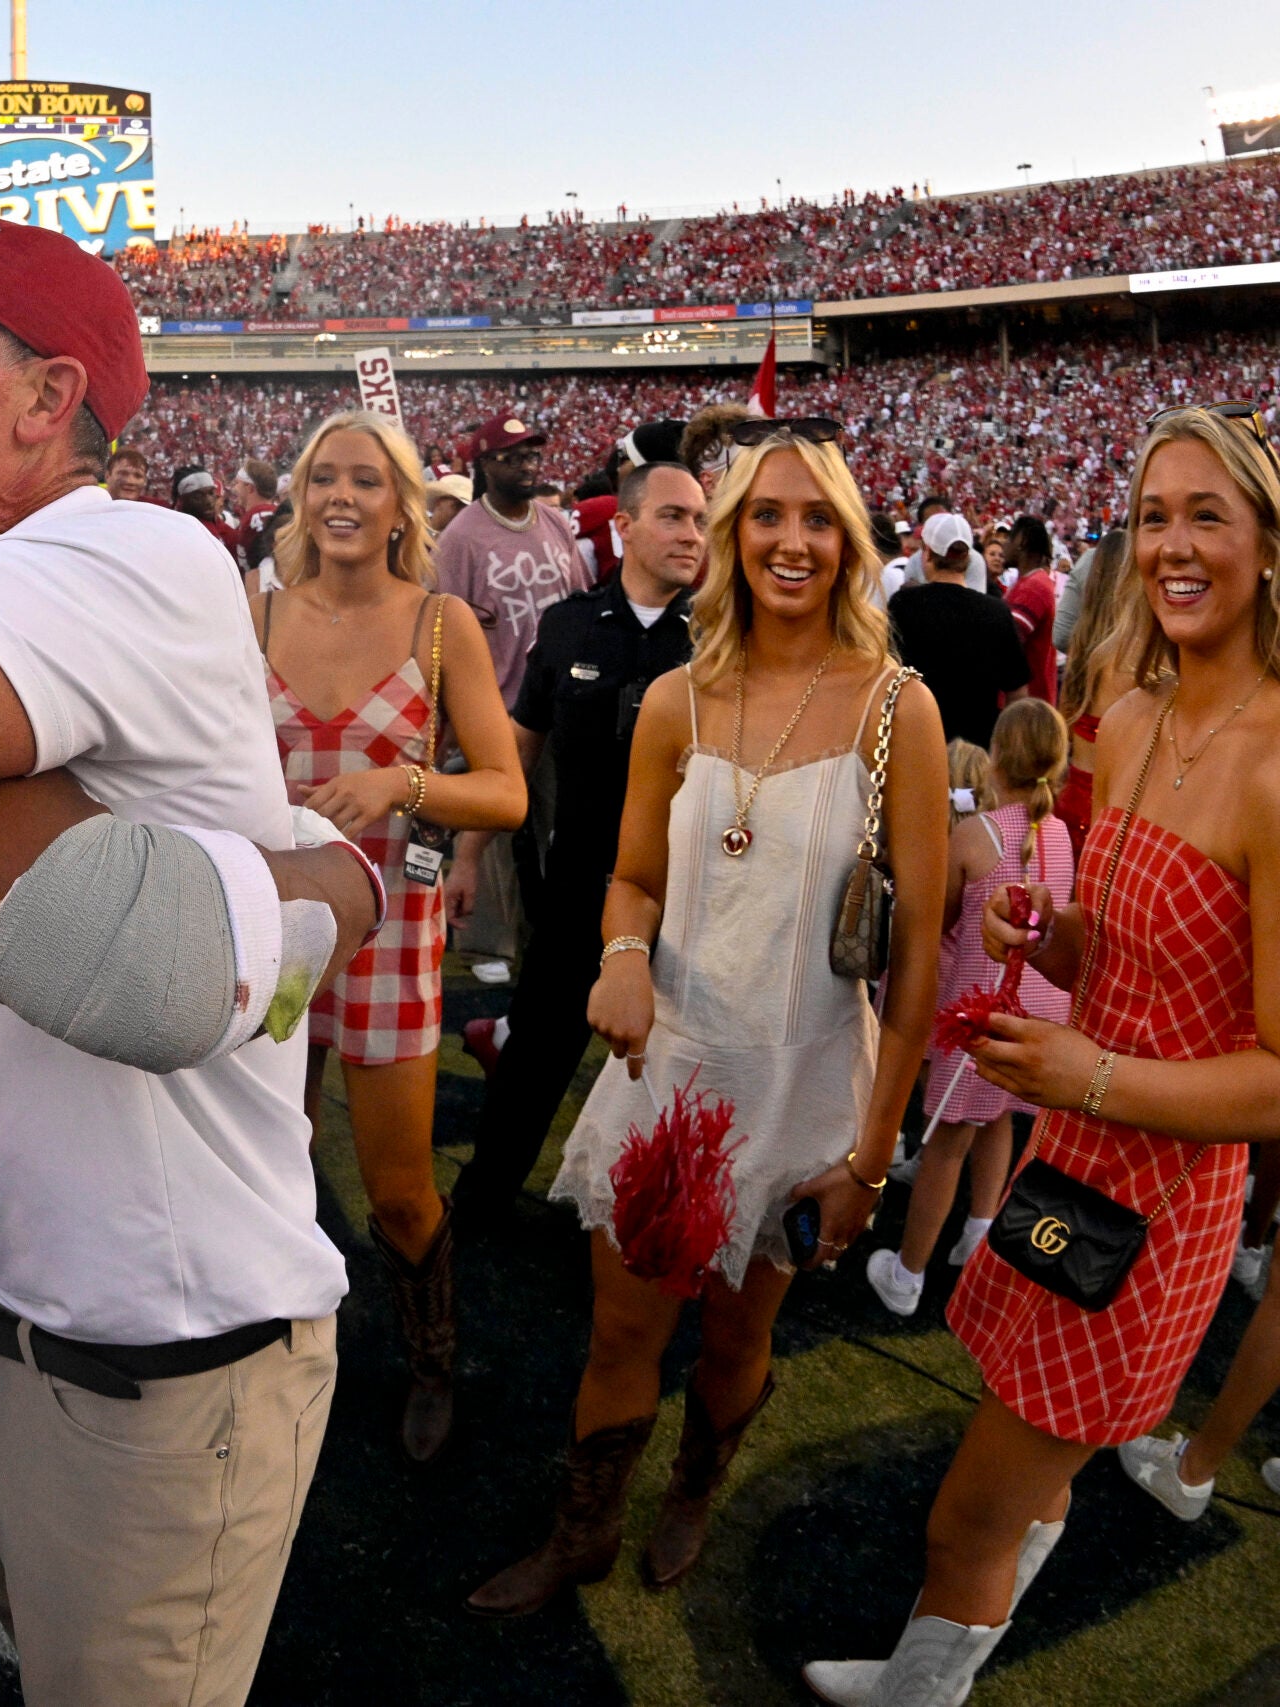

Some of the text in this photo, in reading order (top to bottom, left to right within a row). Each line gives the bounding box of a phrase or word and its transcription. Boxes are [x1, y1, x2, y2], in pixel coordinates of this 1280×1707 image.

[31, 84, 45, 93] TO
[48, 84, 70, 93] THE
[39, 94, 118, 115] BOWL
